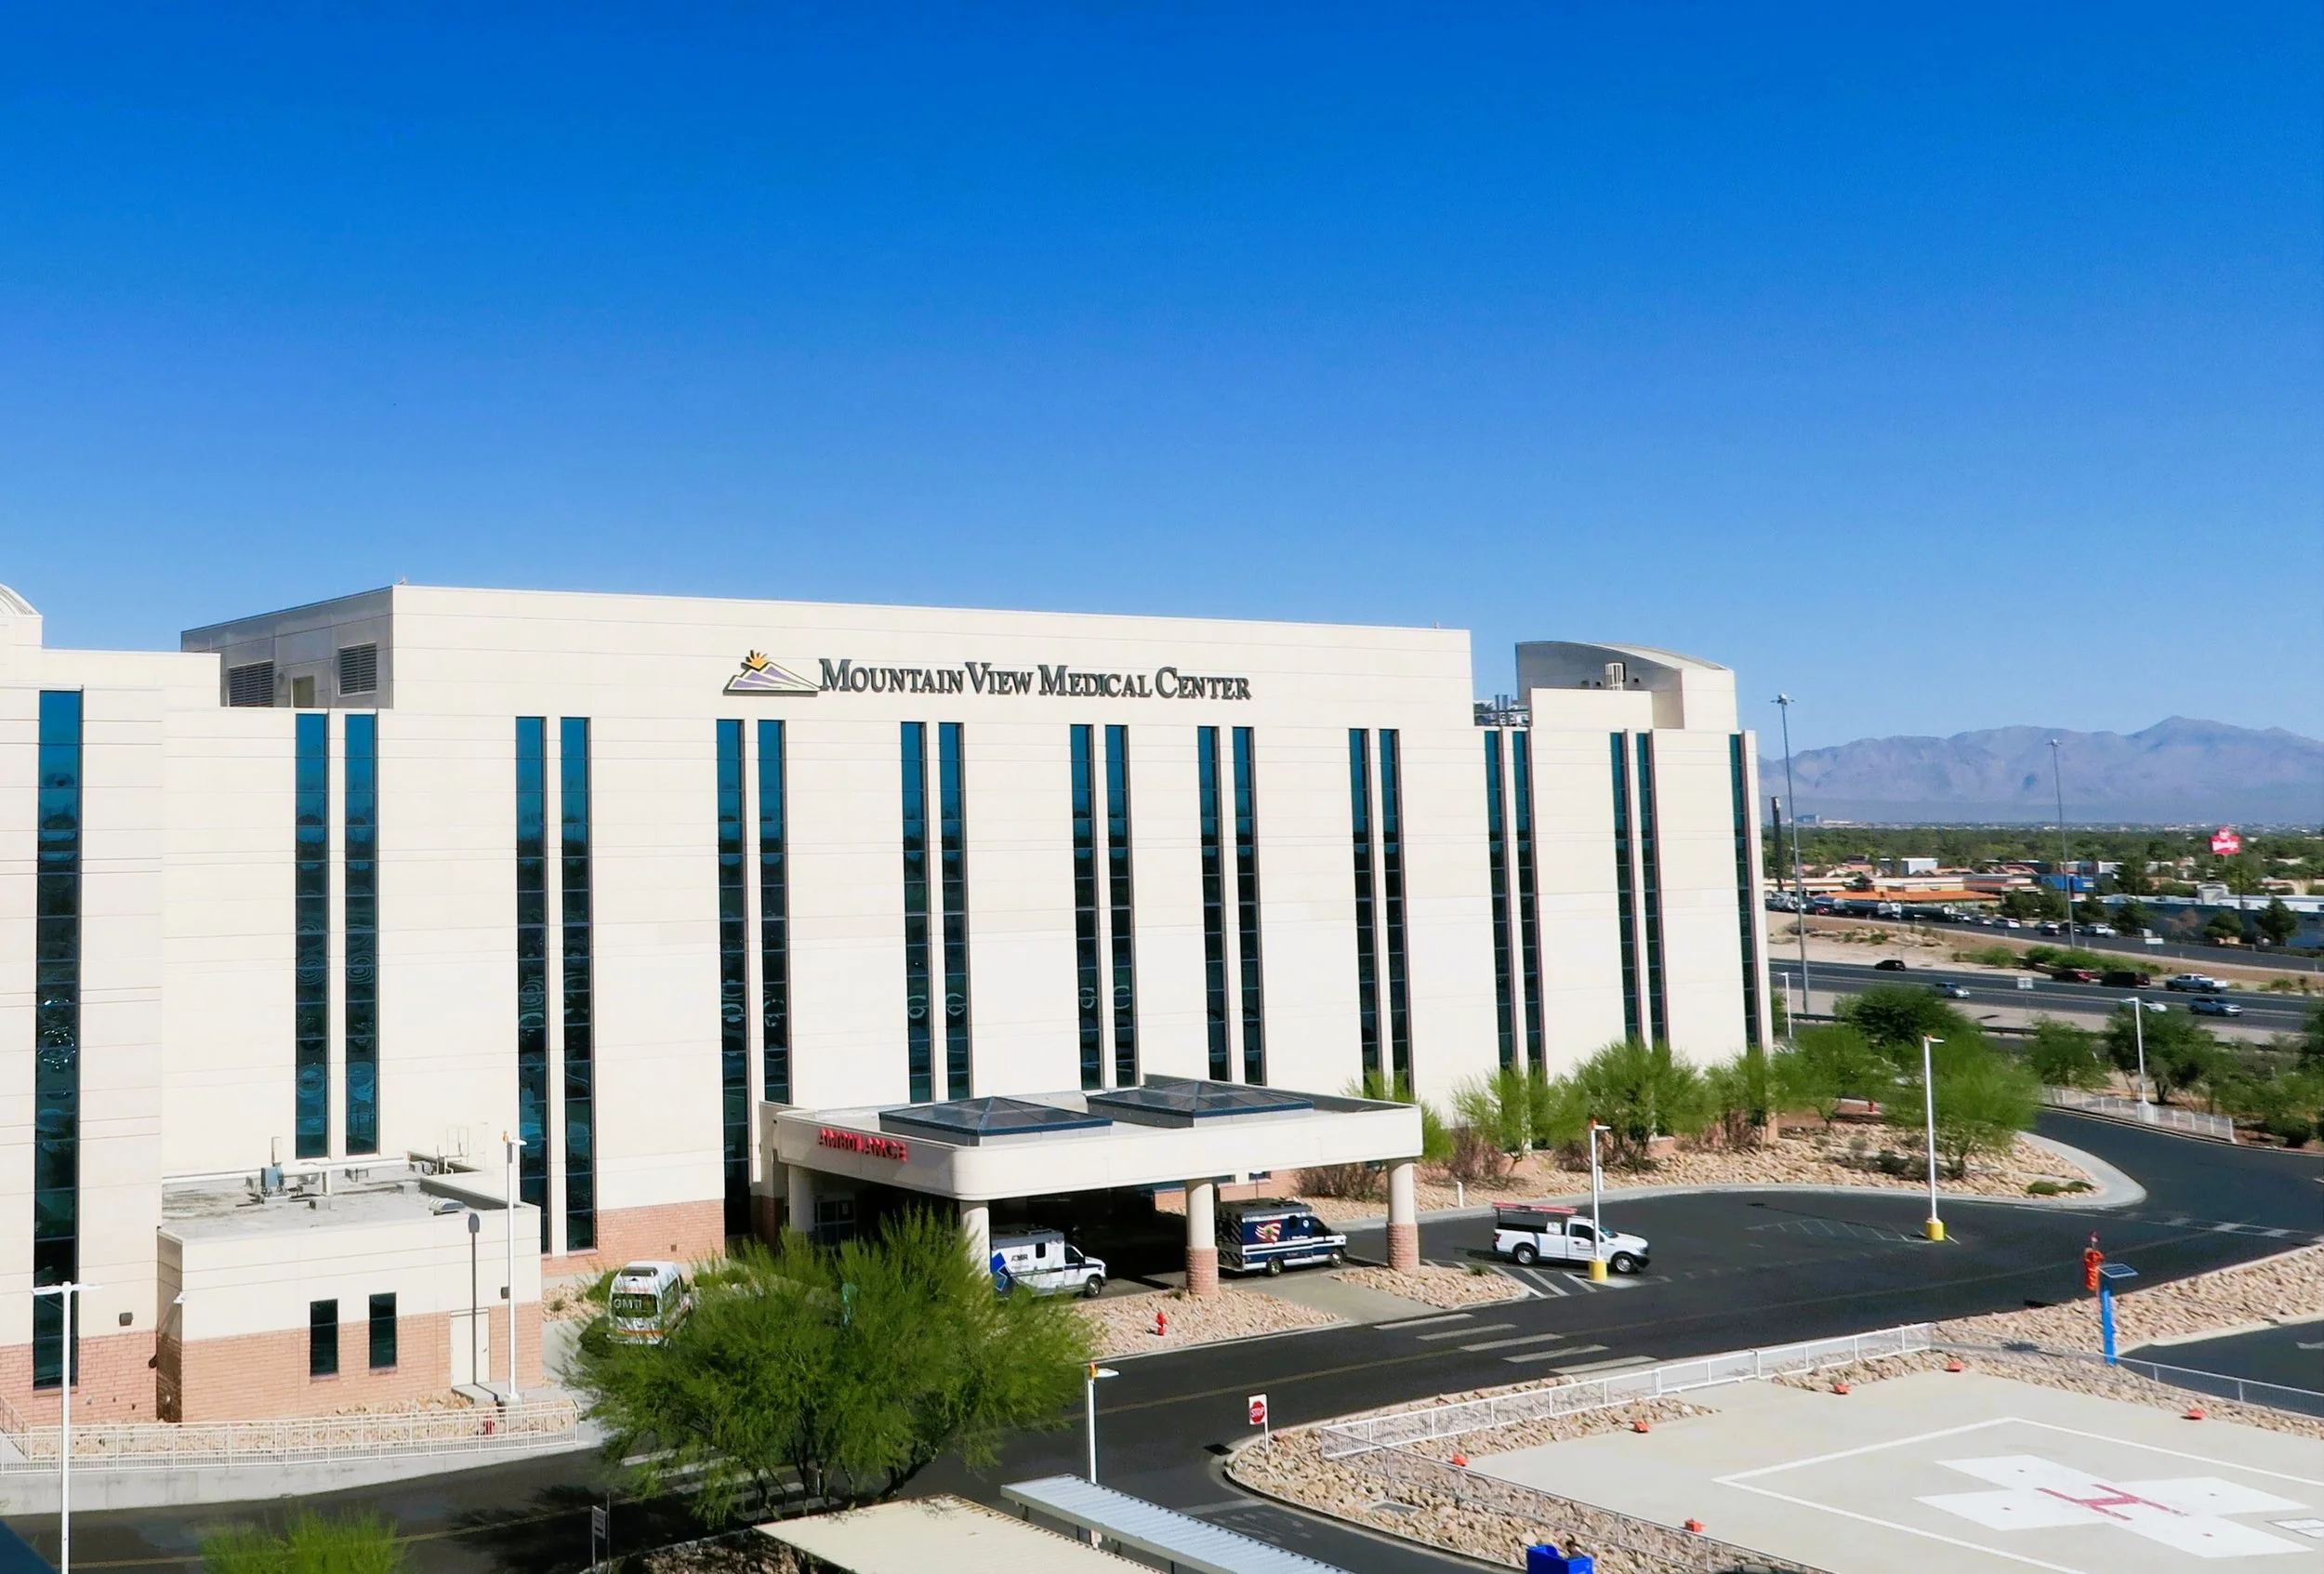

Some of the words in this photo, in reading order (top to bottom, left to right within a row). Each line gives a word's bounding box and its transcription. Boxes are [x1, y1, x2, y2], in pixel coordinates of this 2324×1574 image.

[1037, 664, 1153, 697] MEDICAL
[1155, 666, 1253, 700] CENTER
[818, 1126, 908, 1164] AMBULANCE
